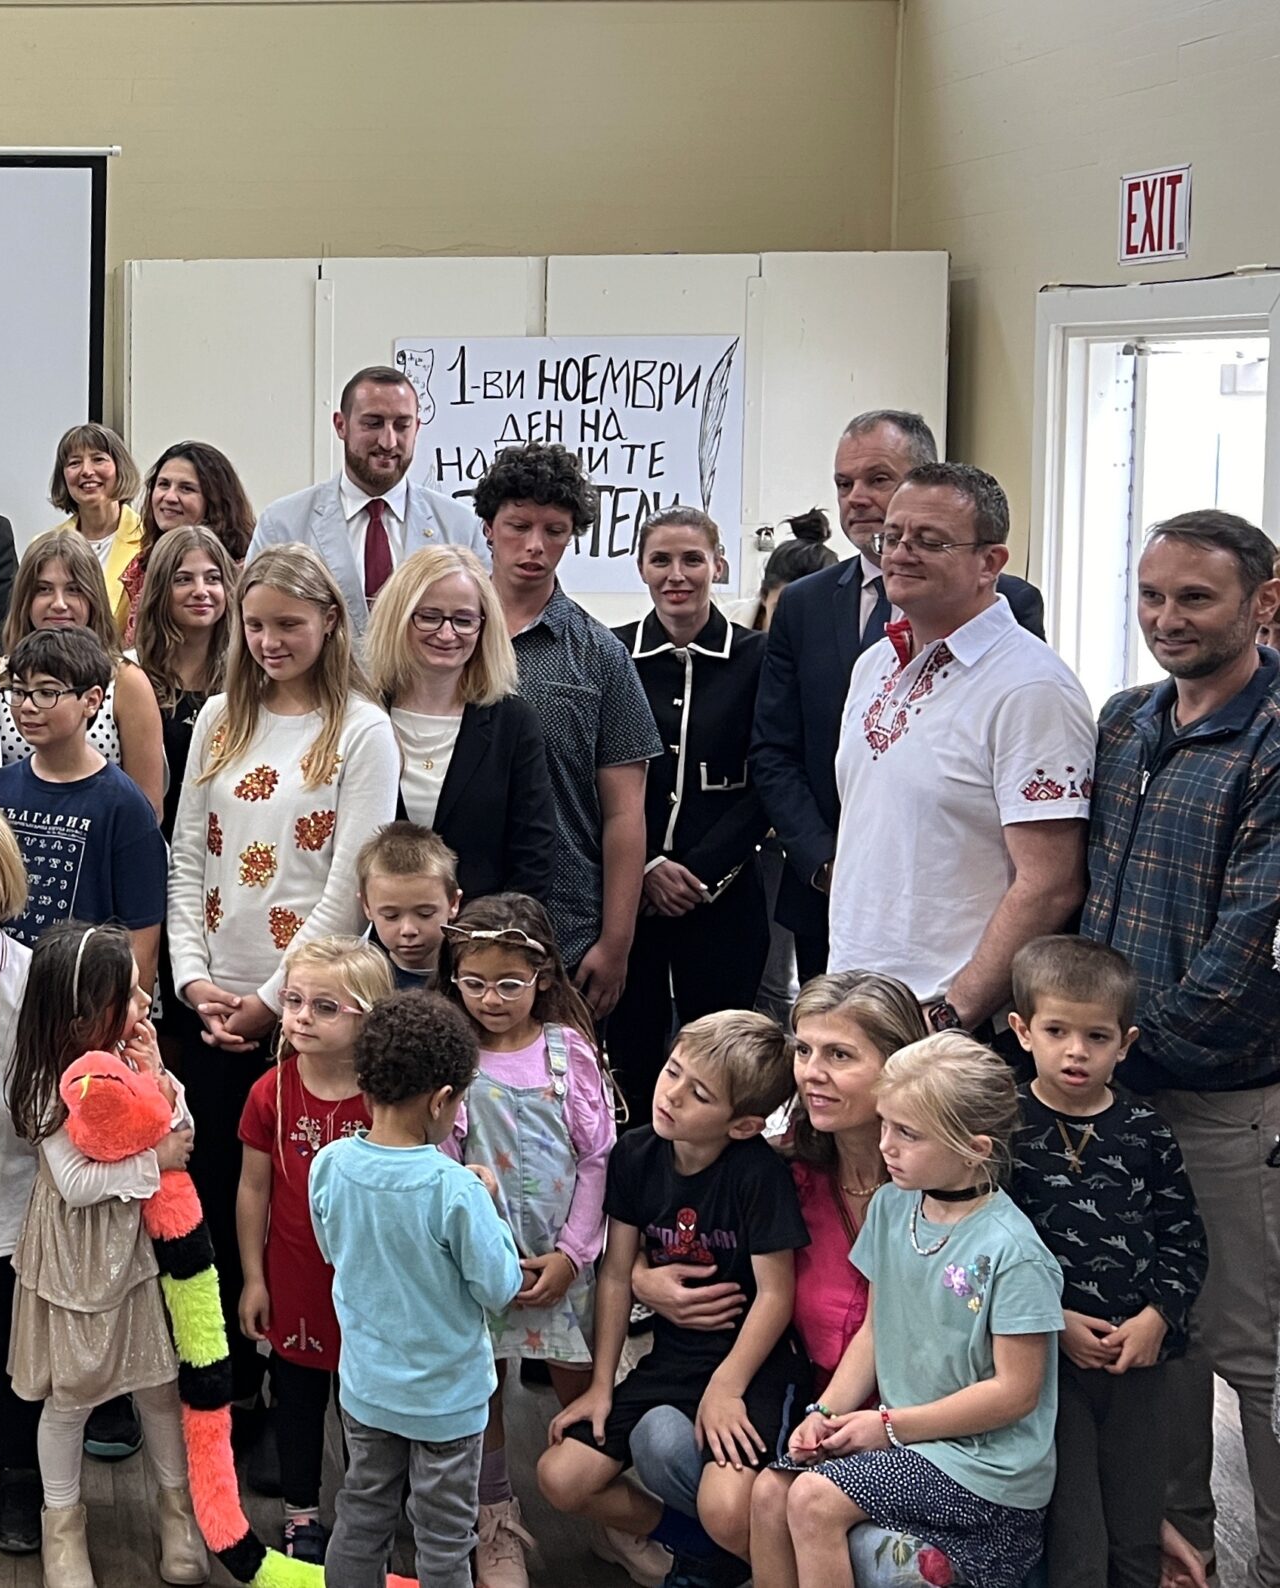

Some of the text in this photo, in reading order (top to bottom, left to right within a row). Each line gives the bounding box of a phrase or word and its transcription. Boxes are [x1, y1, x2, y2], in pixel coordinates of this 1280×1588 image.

[1126, 174, 1183, 255] EXIT
[538, 354, 702, 412] НОЕМВРИ
[494, 408, 563, 447] ДЕН
